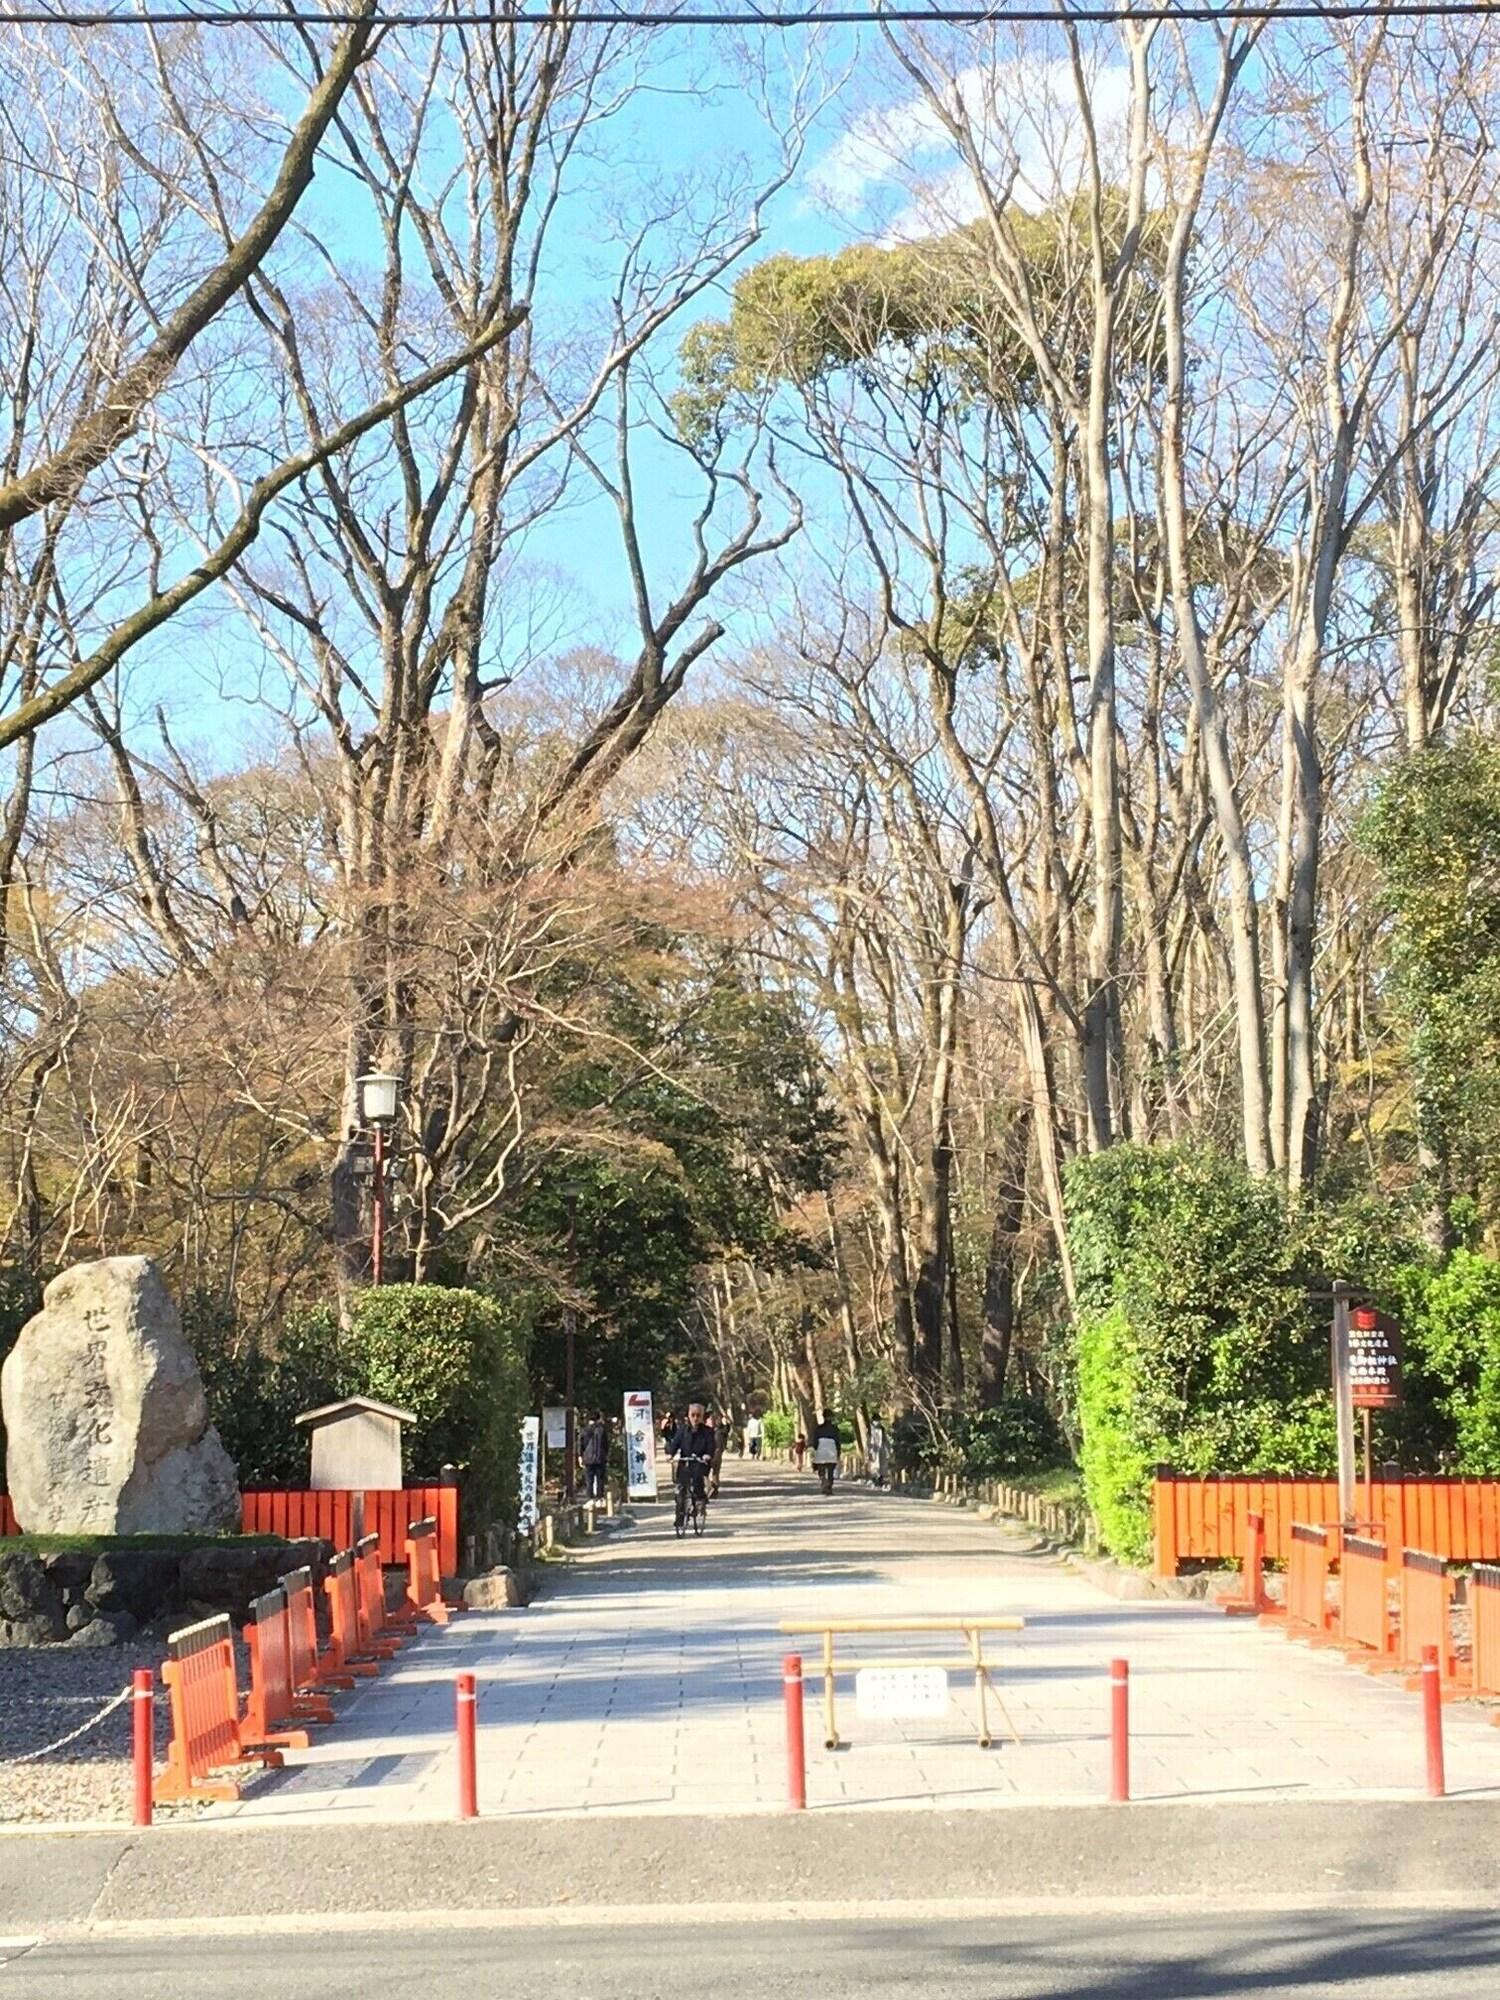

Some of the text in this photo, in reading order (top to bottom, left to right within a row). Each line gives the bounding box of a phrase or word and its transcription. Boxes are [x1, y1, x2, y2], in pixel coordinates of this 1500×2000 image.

[80, 1307, 114, 1525] 世界文化遺産
